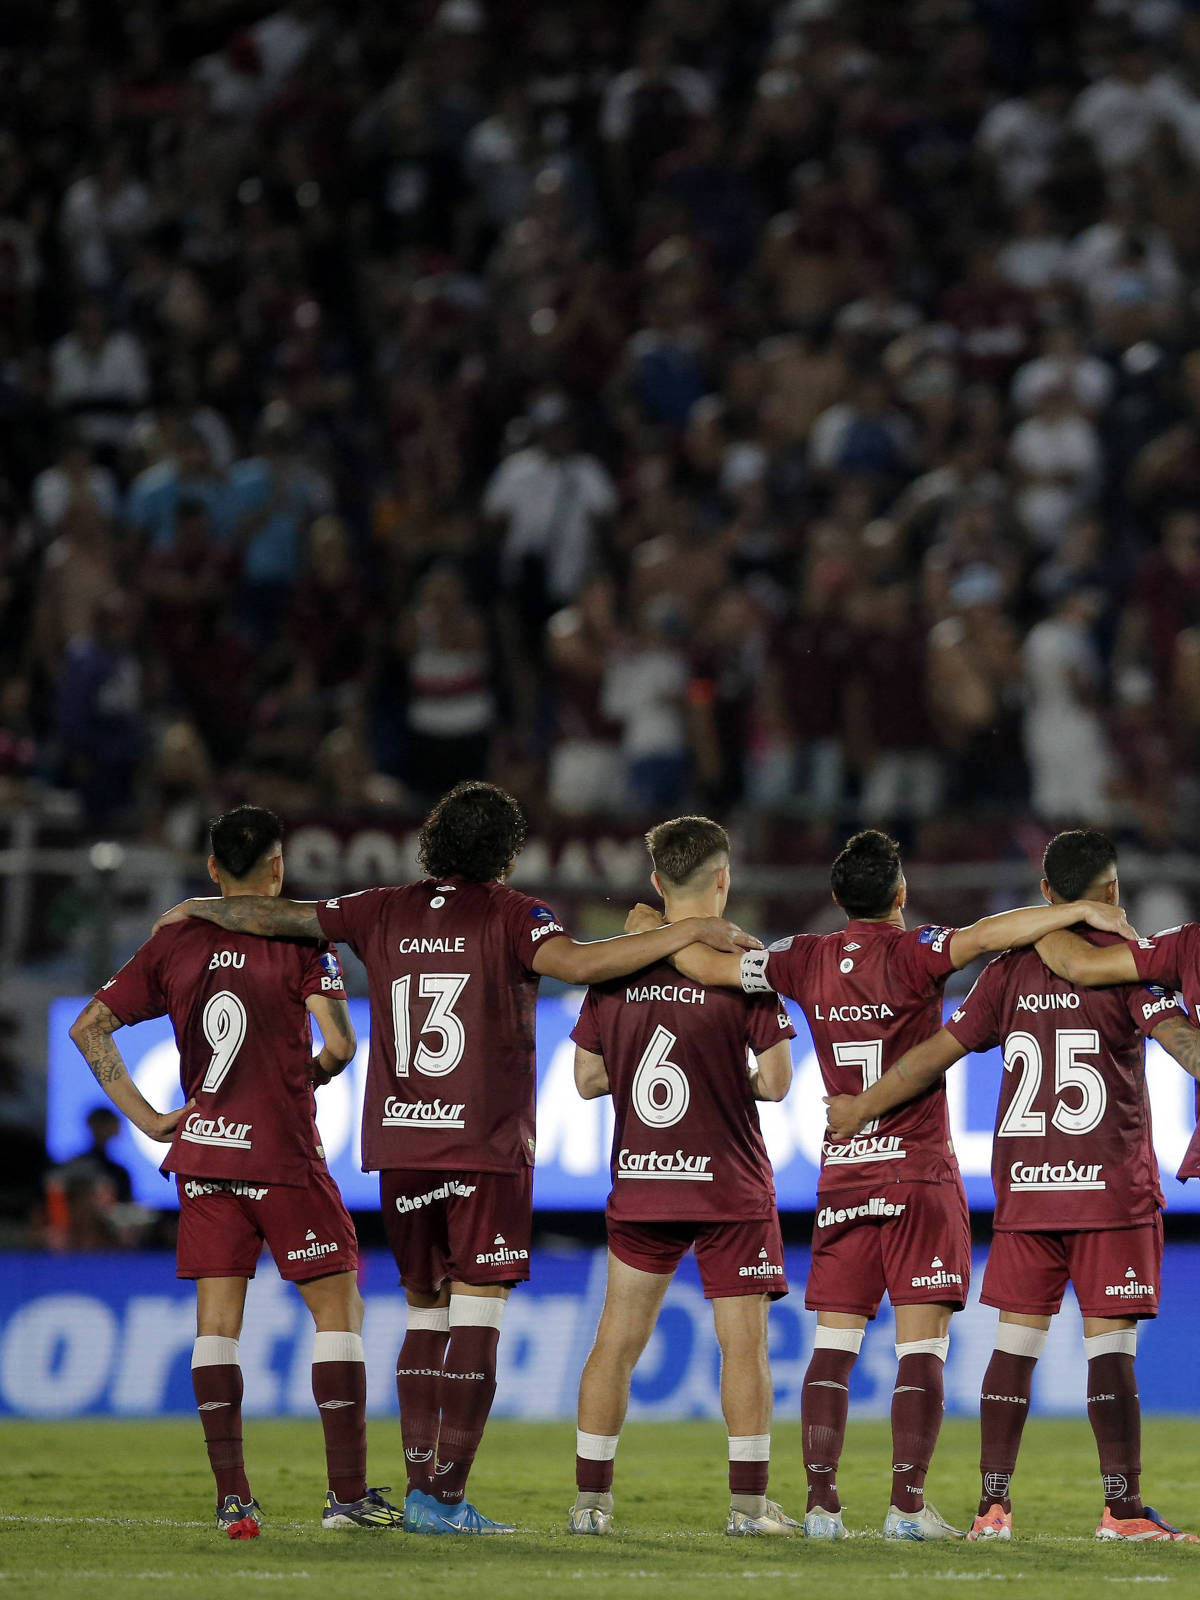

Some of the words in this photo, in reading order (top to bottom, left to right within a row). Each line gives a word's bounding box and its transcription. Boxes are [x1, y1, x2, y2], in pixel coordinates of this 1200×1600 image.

[399, 937, 466, 954] CANALE
[208, 950, 247, 971] BOU
[625, 985, 706, 1005] MARCICH
[1016, 993, 1080, 1013] AQUINO
[390, 972, 472, 1078] 13
[202, 990, 248, 1094] 9
[631, 1023, 691, 1129] 6
[997, 1028, 1108, 1138] 25
[832, 1038, 884, 1137] 7
[384, 1095, 466, 1120] CartaSur
[618, 1148, 712, 1172] CartaSur
[1010, 1159, 1103, 1183] CartaSur
[816, 1197, 907, 1228] Chevallier
[287, 1241, 340, 1262] andina
[475, 1247, 529, 1265] andina
[738, 1262, 784, 1277] andina
[911, 1270, 963, 1288] andina
[1105, 1281, 1155, 1296] andina
